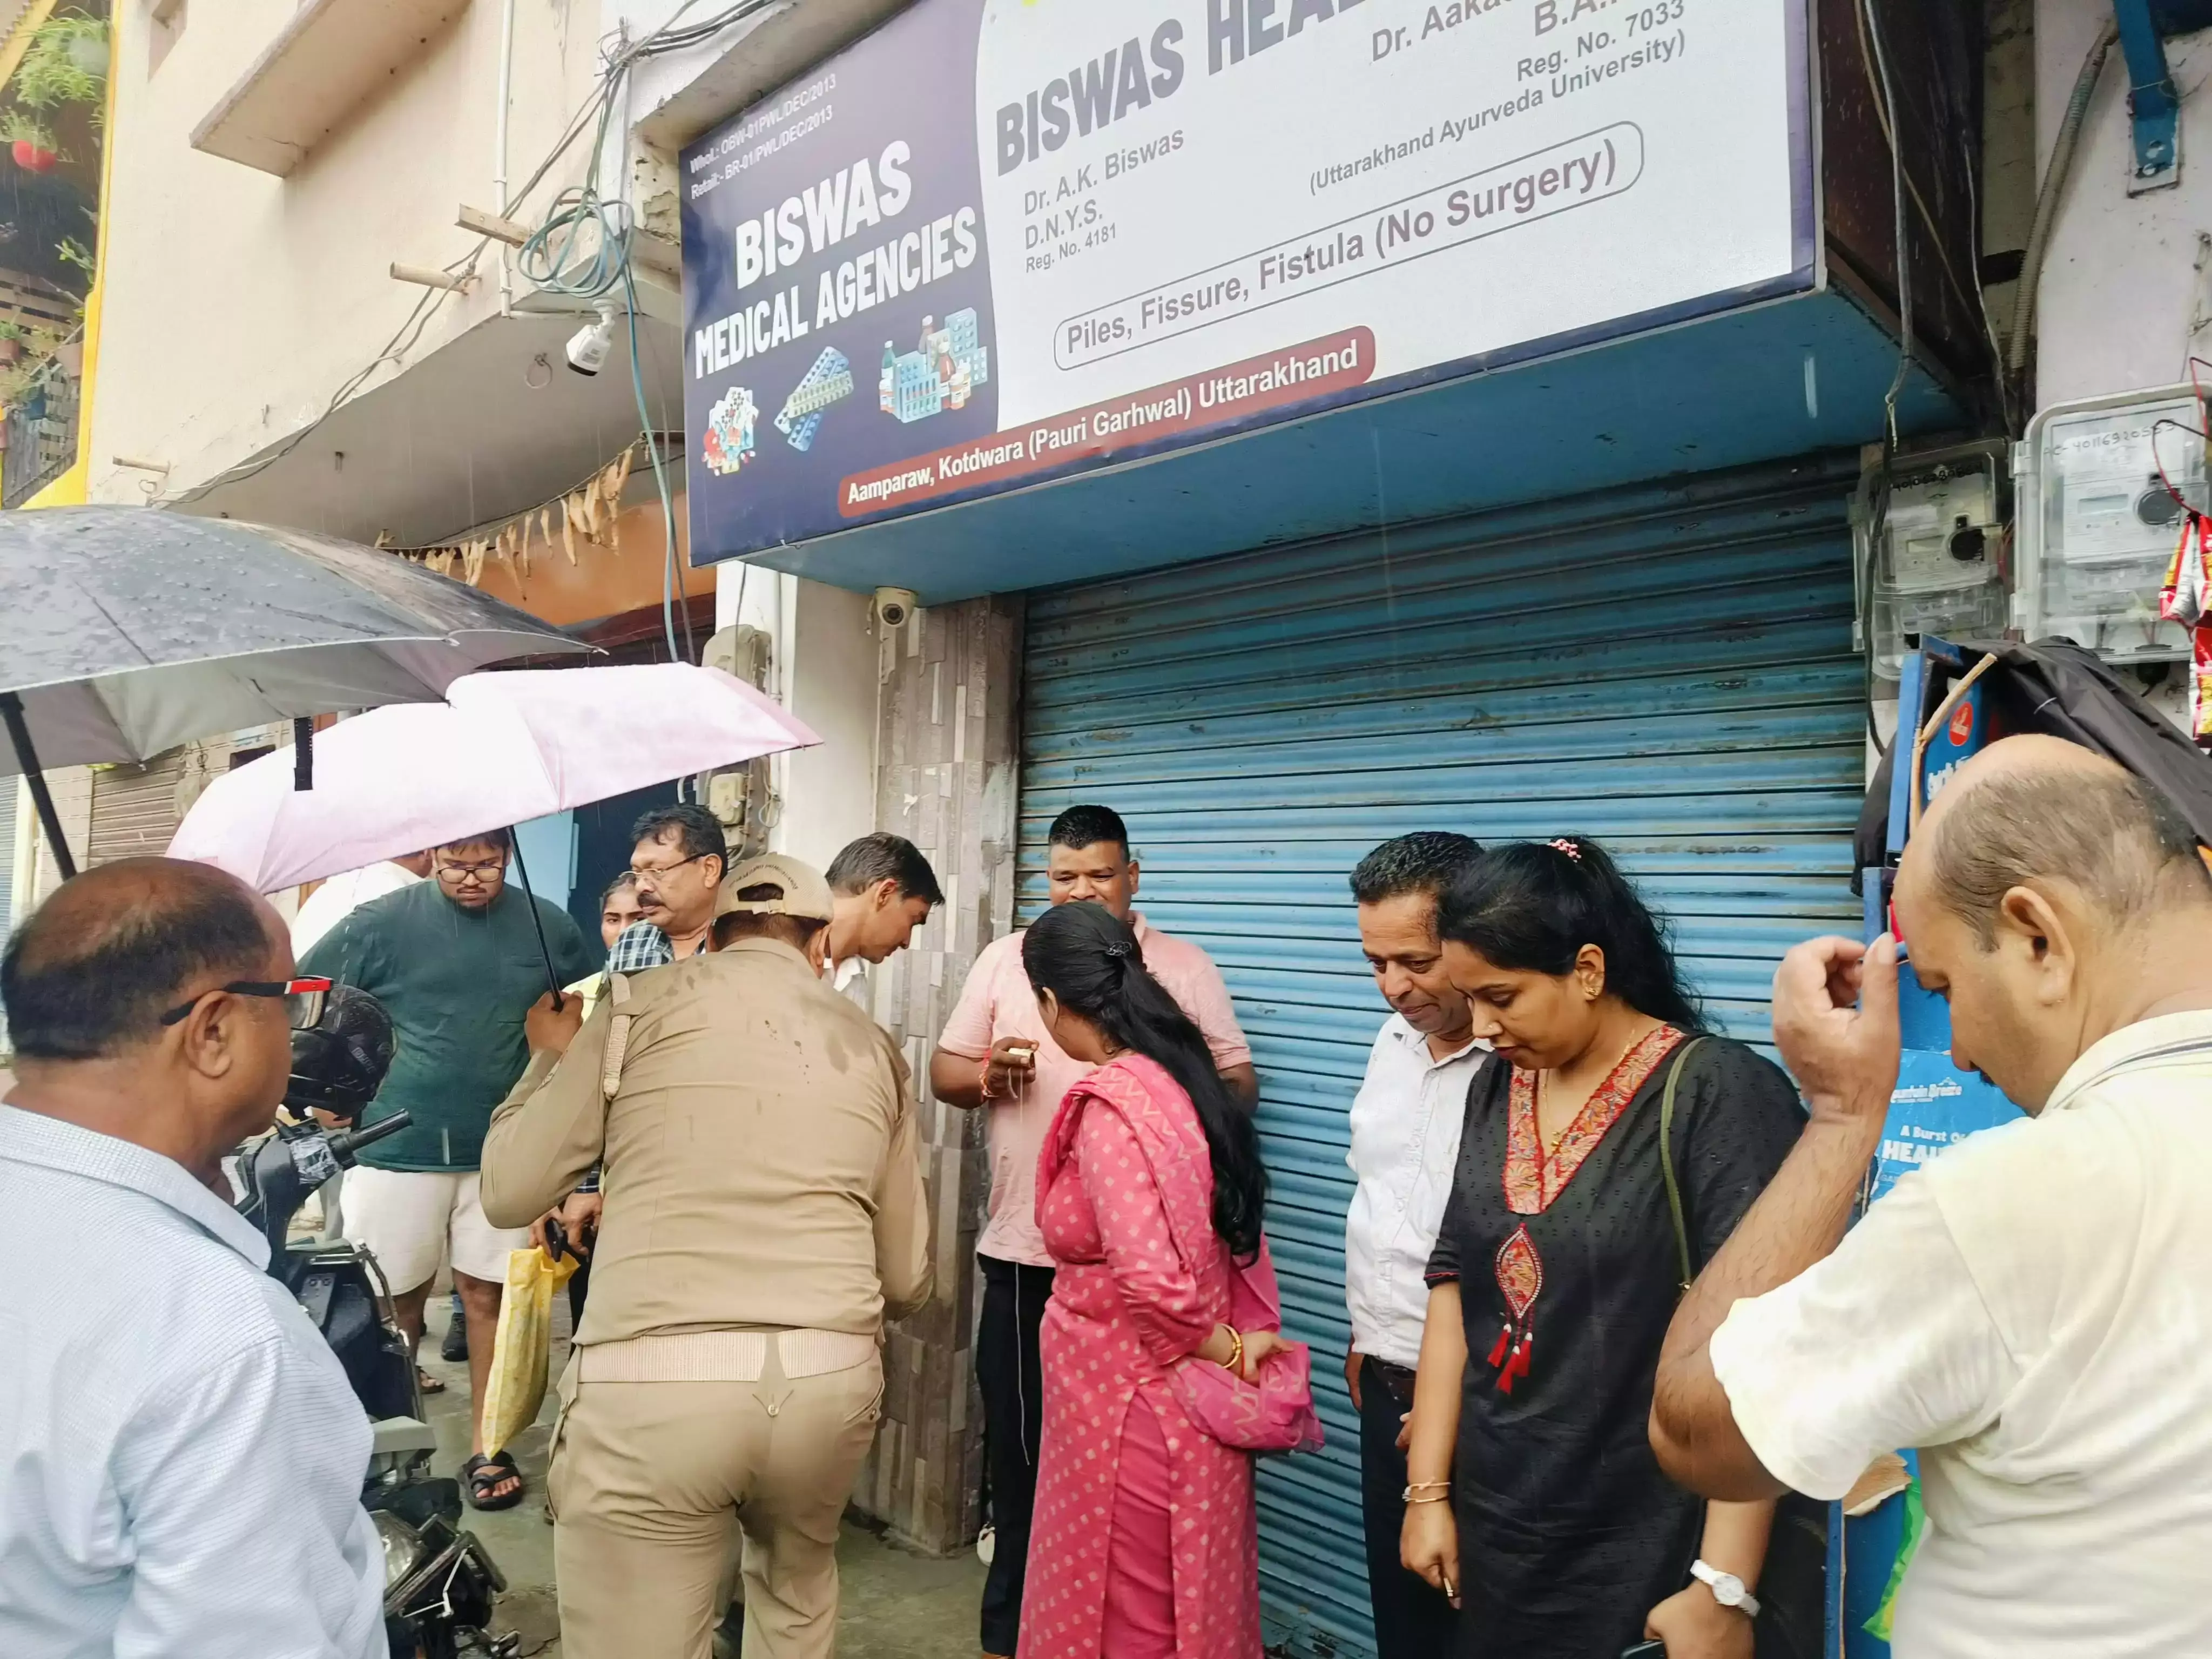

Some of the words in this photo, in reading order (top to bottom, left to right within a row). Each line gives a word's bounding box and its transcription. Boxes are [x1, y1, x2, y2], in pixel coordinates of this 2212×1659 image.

[996, 19, 1184, 177] BISWAS
[1373, 26, 1412, 62] Dr.
[1517, 50, 1568, 82] Reg.
[1577, 32, 1616, 57] No.
[1625, 0, 1684, 37] 7033
[1310, 127, 1434, 195] (Uttarakhand
[1439, 89, 1543, 143] Ayurveda
[1551, 29, 1685, 98] University)
[736, 140, 912, 289] BISWAS
[1025, 190, 1050, 215] Dr.
[1056, 163, 1097, 201] A.K.
[1105, 130, 1184, 180] Biswas
[1026, 199, 1103, 249] D.N.Y.S.
[695, 285, 808, 379] MEDICAL
[816, 206, 976, 329] AGENCIES
[1026, 253, 1054, 273] Reg.
[1059, 241, 1081, 260] No.
[1084, 222, 1116, 248] 4181
[1068, 316, 1132, 354] Piles,
[1141, 276, 1249, 329] Fissure,
[1260, 232, 1364, 290] Fistula
[1375, 209, 1434, 259] (No
[1447, 138, 1616, 227] Surgery)
[847, 467, 935, 504] Aamparaw,
[939, 441, 1023, 479] Kotdwara
[1029, 417, 1087, 460] (Pauri
[1093, 387, 1191, 436] Garhwal)
[1198, 339, 1357, 408] Uttarakhand
[1900, 1125, 1910, 1136] A
[1913, 1126, 1947, 1142] Burst
